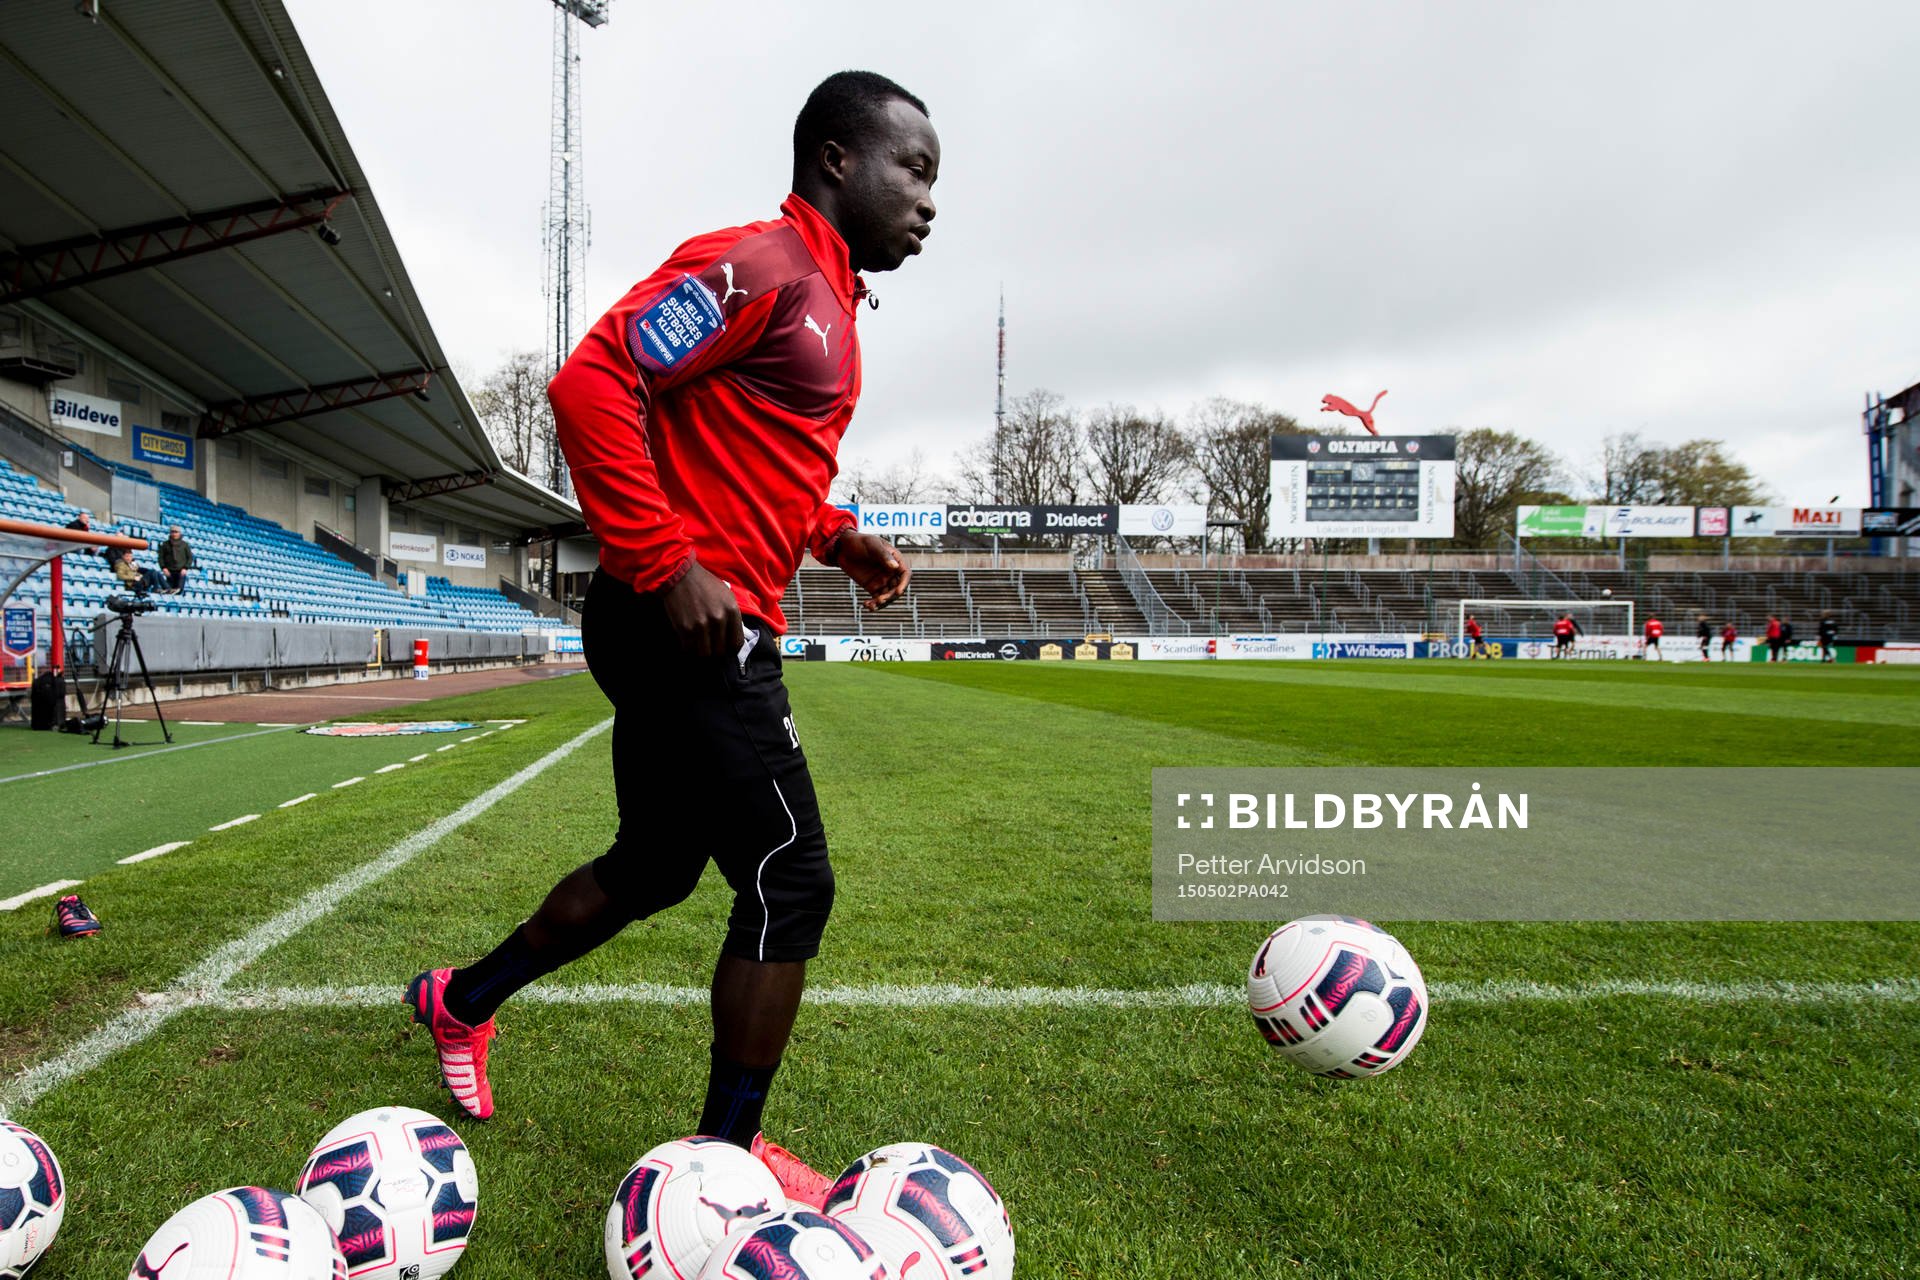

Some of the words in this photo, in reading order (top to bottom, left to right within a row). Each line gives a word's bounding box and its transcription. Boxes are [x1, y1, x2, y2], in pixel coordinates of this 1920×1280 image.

[668, 297, 702, 340] SVERIGES
[683, 299, 703, 324] HELA
[656, 316, 681, 347] KLUBB
[659, 302, 695, 348] FOTBOLLS
[53, 399, 119, 427] Bildeve
[1328, 440, 1398, 453] OLYMPIA
[864, 511, 942, 527] kemira
[948, 506, 1032, 527] colorama
[460, 553, 484, 561] NOKAS
[1243, 644, 1295, 653] Scandlines
[1344, 643, 1406, 659] Wihlborgs
[783, 713, 800, 749] 2
